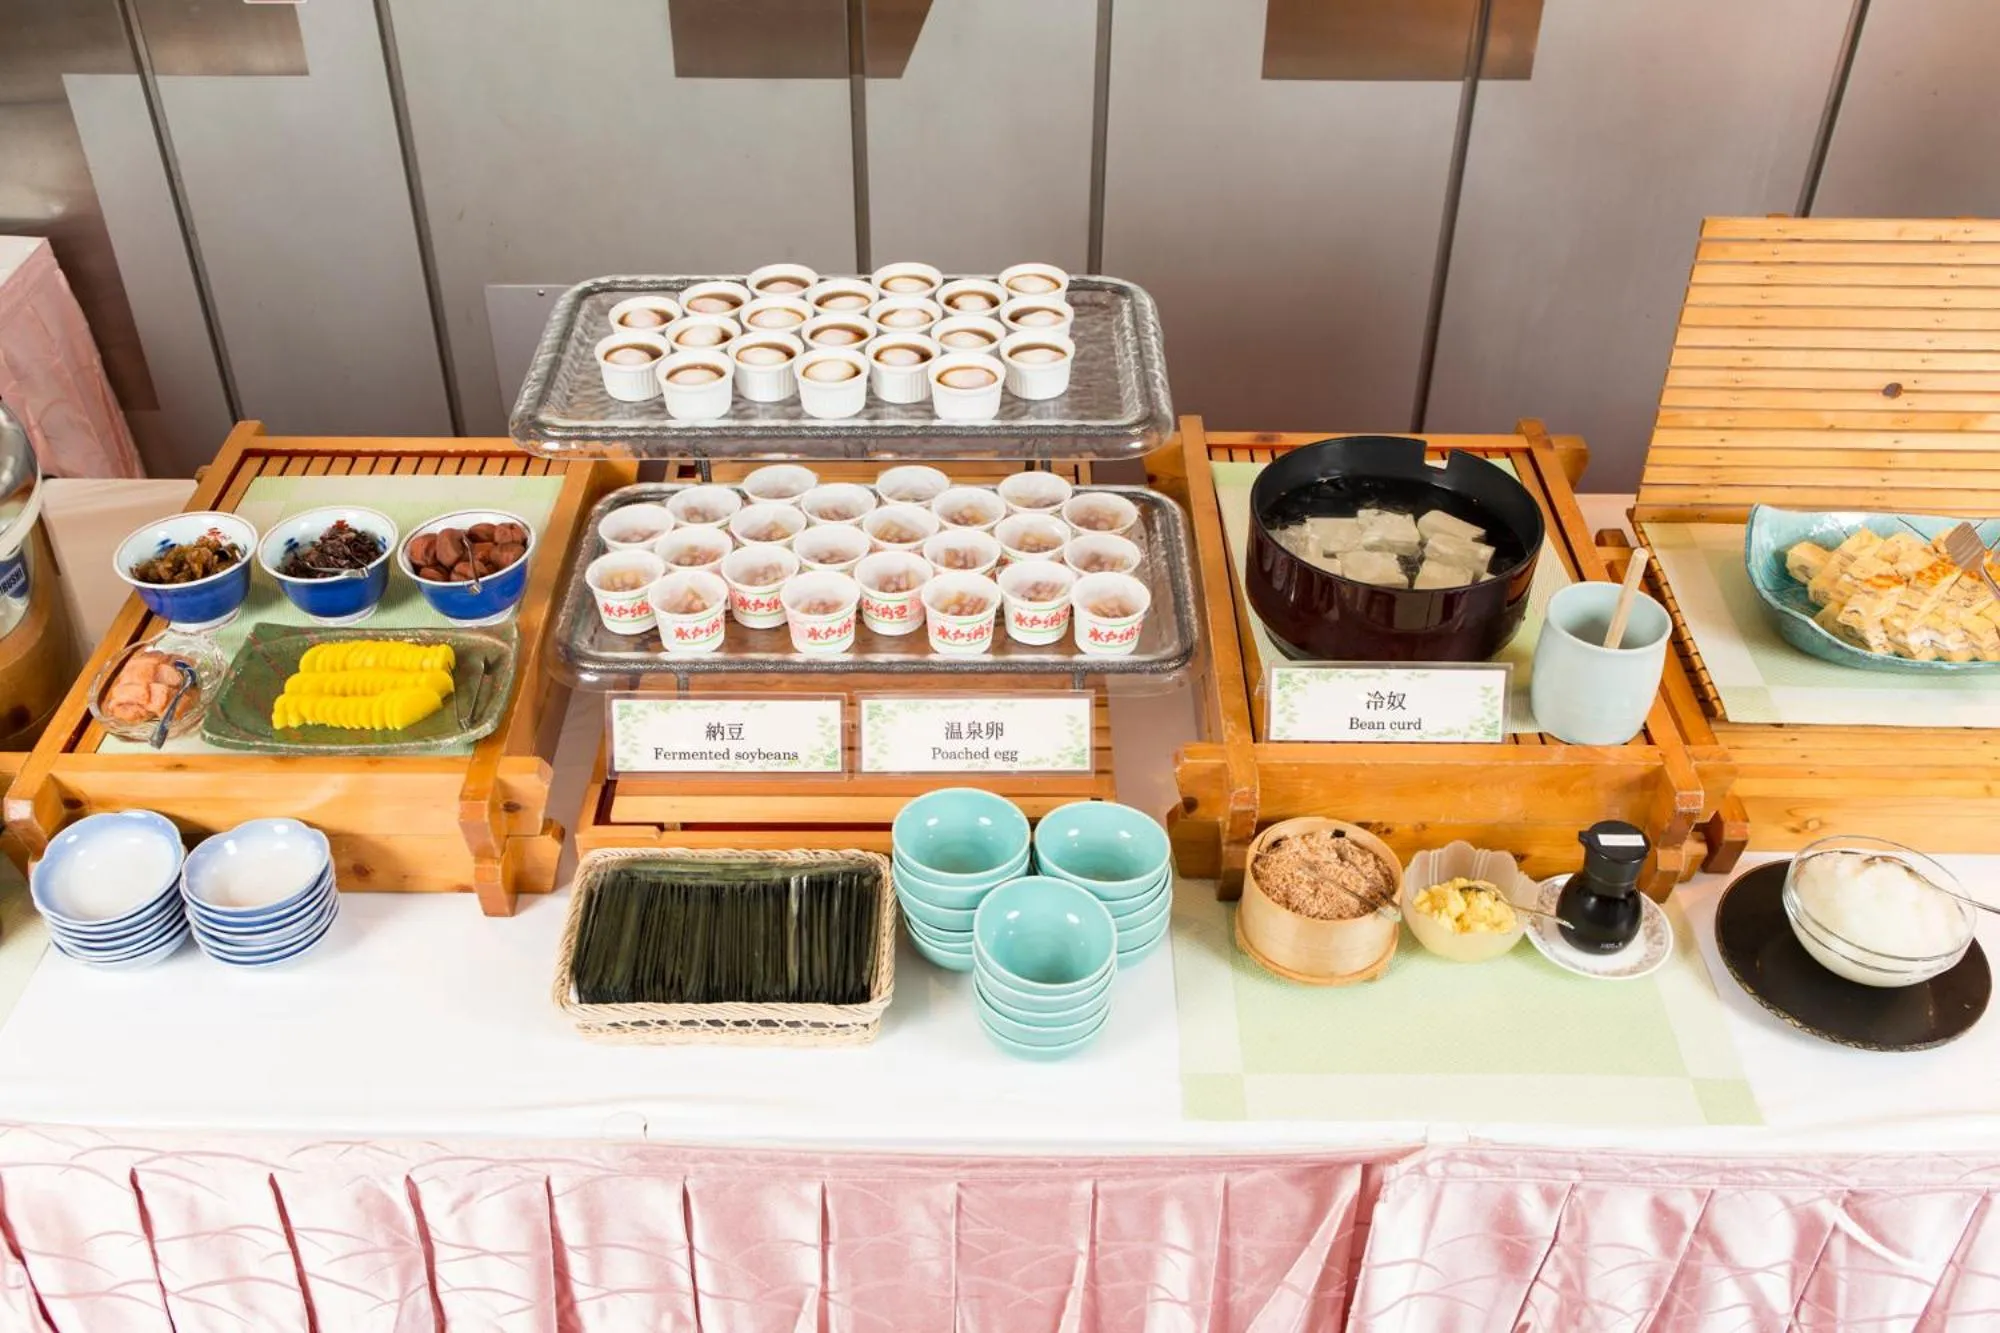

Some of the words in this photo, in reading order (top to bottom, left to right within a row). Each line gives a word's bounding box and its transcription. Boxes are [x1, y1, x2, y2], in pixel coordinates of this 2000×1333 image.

[1365, 689, 1407, 711] 冷奴
[705, 721, 745, 742] 納豆
[944, 720, 1005, 741] 温泉卵
[1349, 717, 1385, 731] Bean
[1389, 717, 1422, 731] curd
[653, 746, 731, 762] Fermented
[734, 747, 799, 764] soybeans
[931, 746, 990, 761] Poached
[993, 748, 1019, 763] egg
